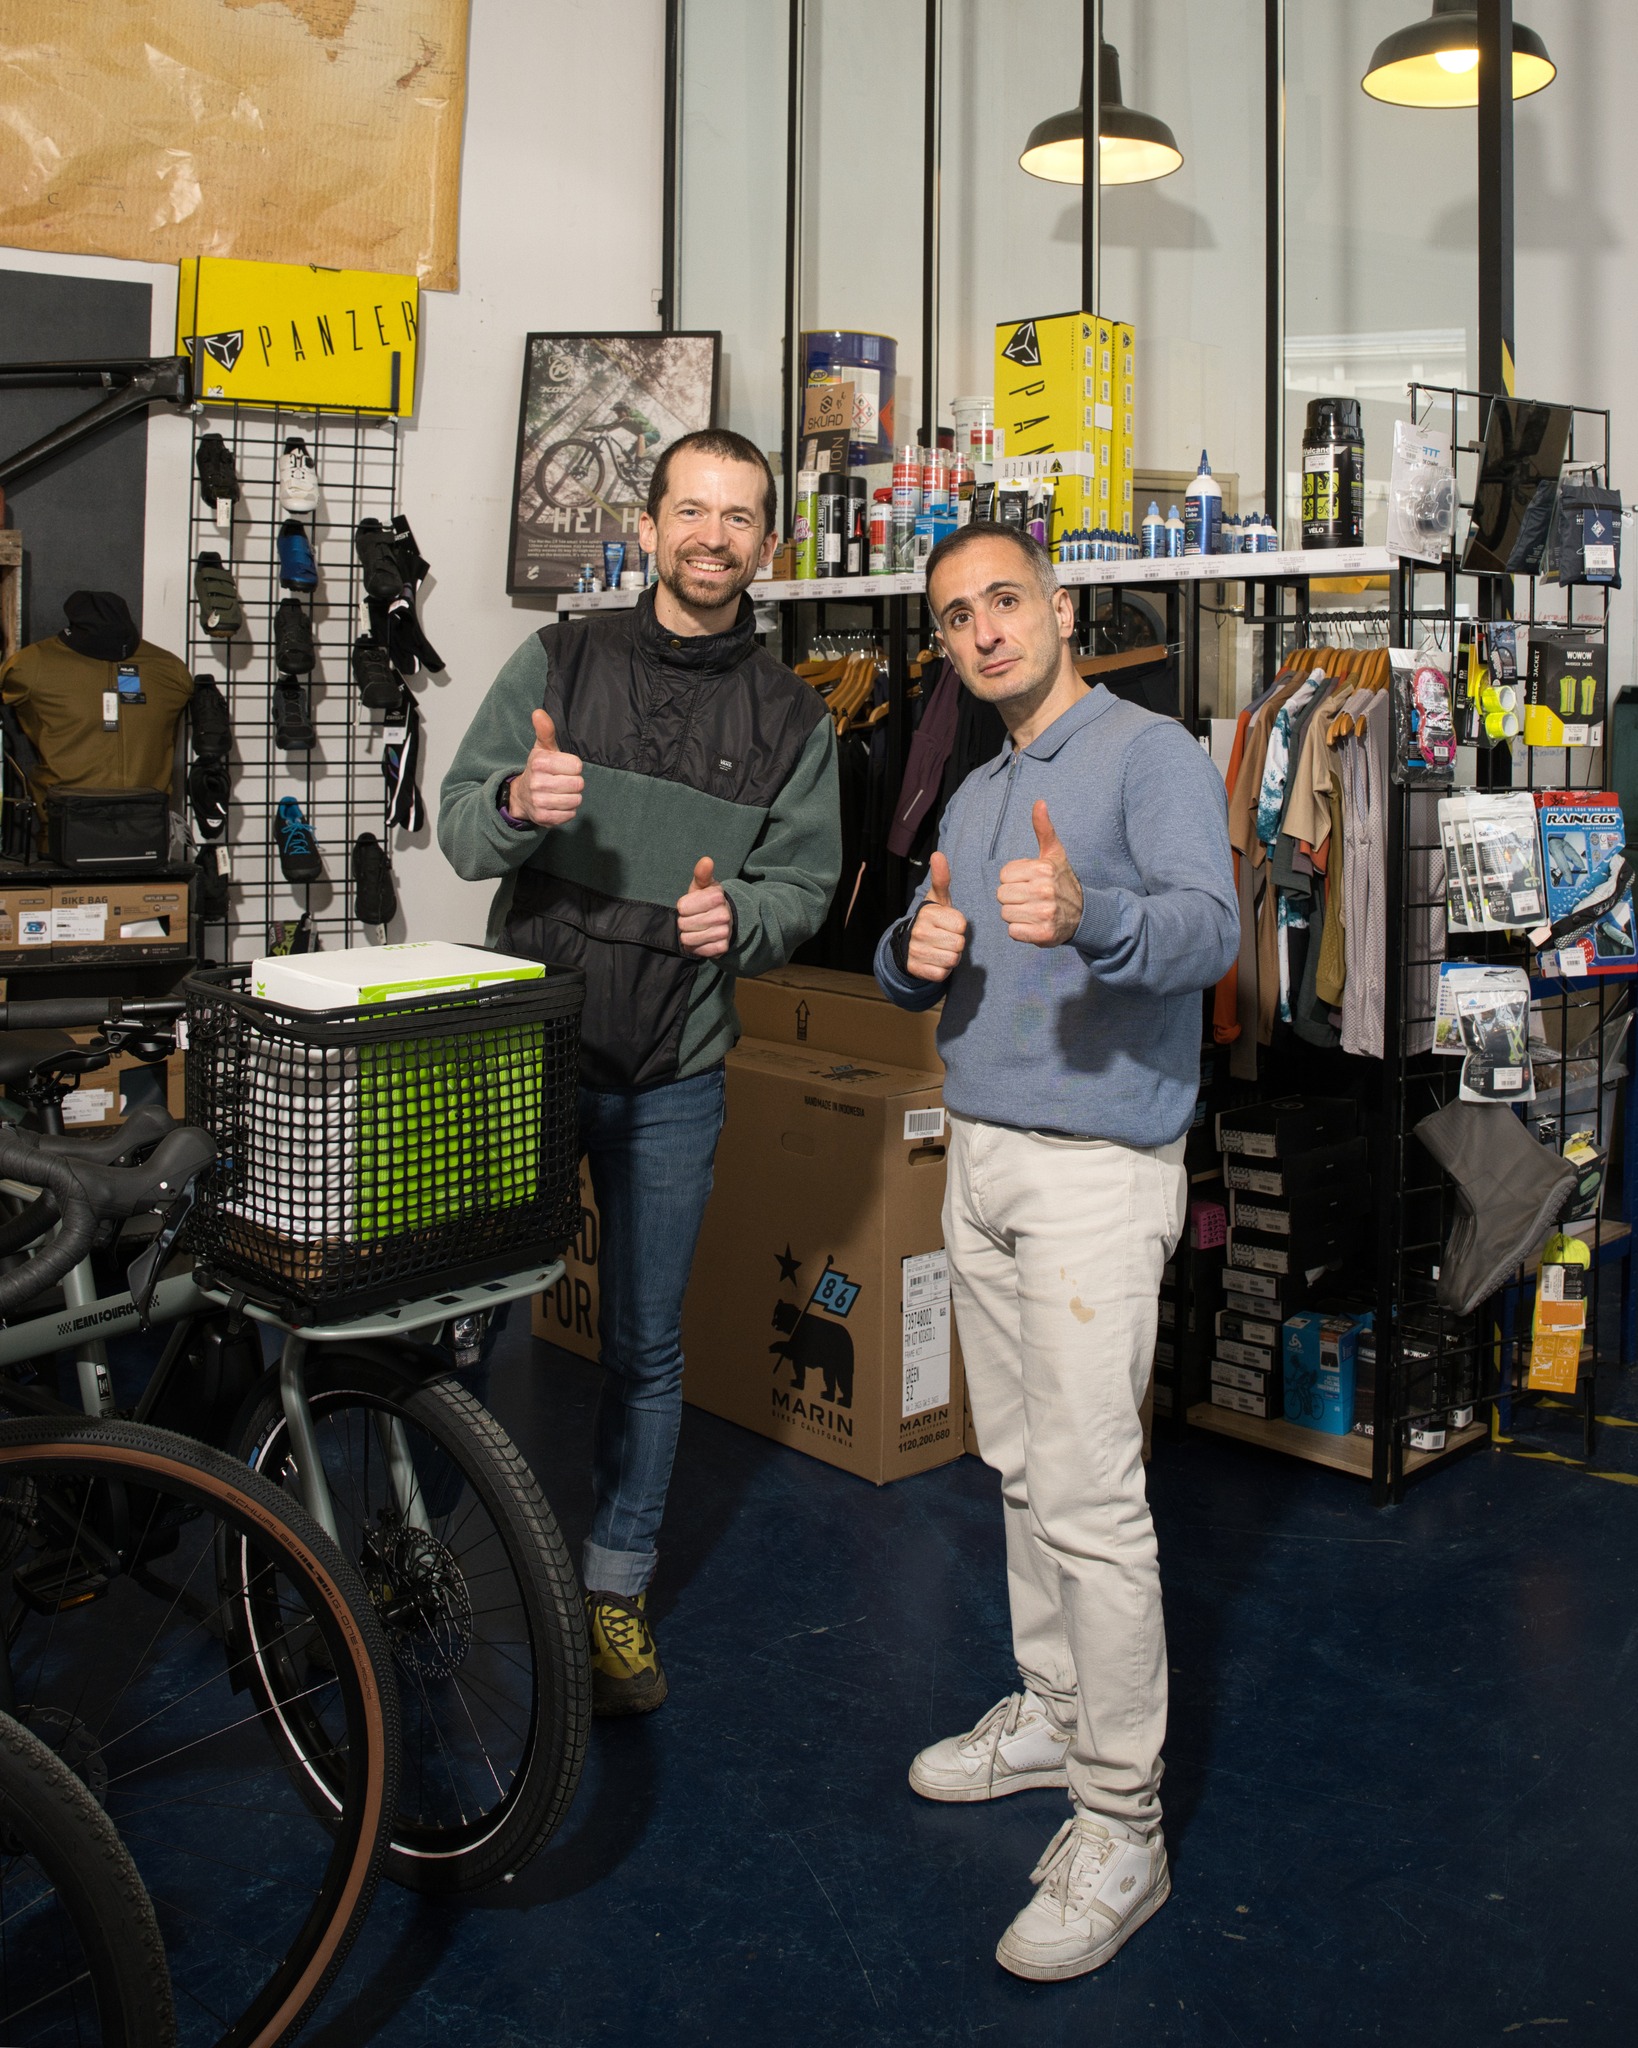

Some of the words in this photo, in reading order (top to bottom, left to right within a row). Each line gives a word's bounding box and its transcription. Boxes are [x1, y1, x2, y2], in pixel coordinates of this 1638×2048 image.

[259, 301, 416, 367] PANZER
[808, 413, 843, 430] SKUAD
[1567, 651, 1593, 660] WOWOW
[1547, 814, 1616, 824] RAINLEGS
[61, 896, 85, 905] BIKE
[88, 895, 108, 904] BAG
[804, 1096, 831, 1111] HANDMADE
[832, 1102, 838, 1112] IN
[838, 1102, 865, 1117] INDONESIA
[822, 1278, 848, 1309] 86
[99, 1302, 140, 1323] FOURCH
[906, 1384, 913, 1402] 52
[772, 1387, 853, 1437] MARIN
[900, 1408, 948, 1433] MARIN
[800, 1422, 853, 1449] CALIFORNIA
[898, 1428, 950, 1454] 1120,200,680
[1415, 1431, 1424, 1441] M
[226, 1492, 295, 1551] SCHWALBE
[332, 1599, 358, 1646] G-ONE
